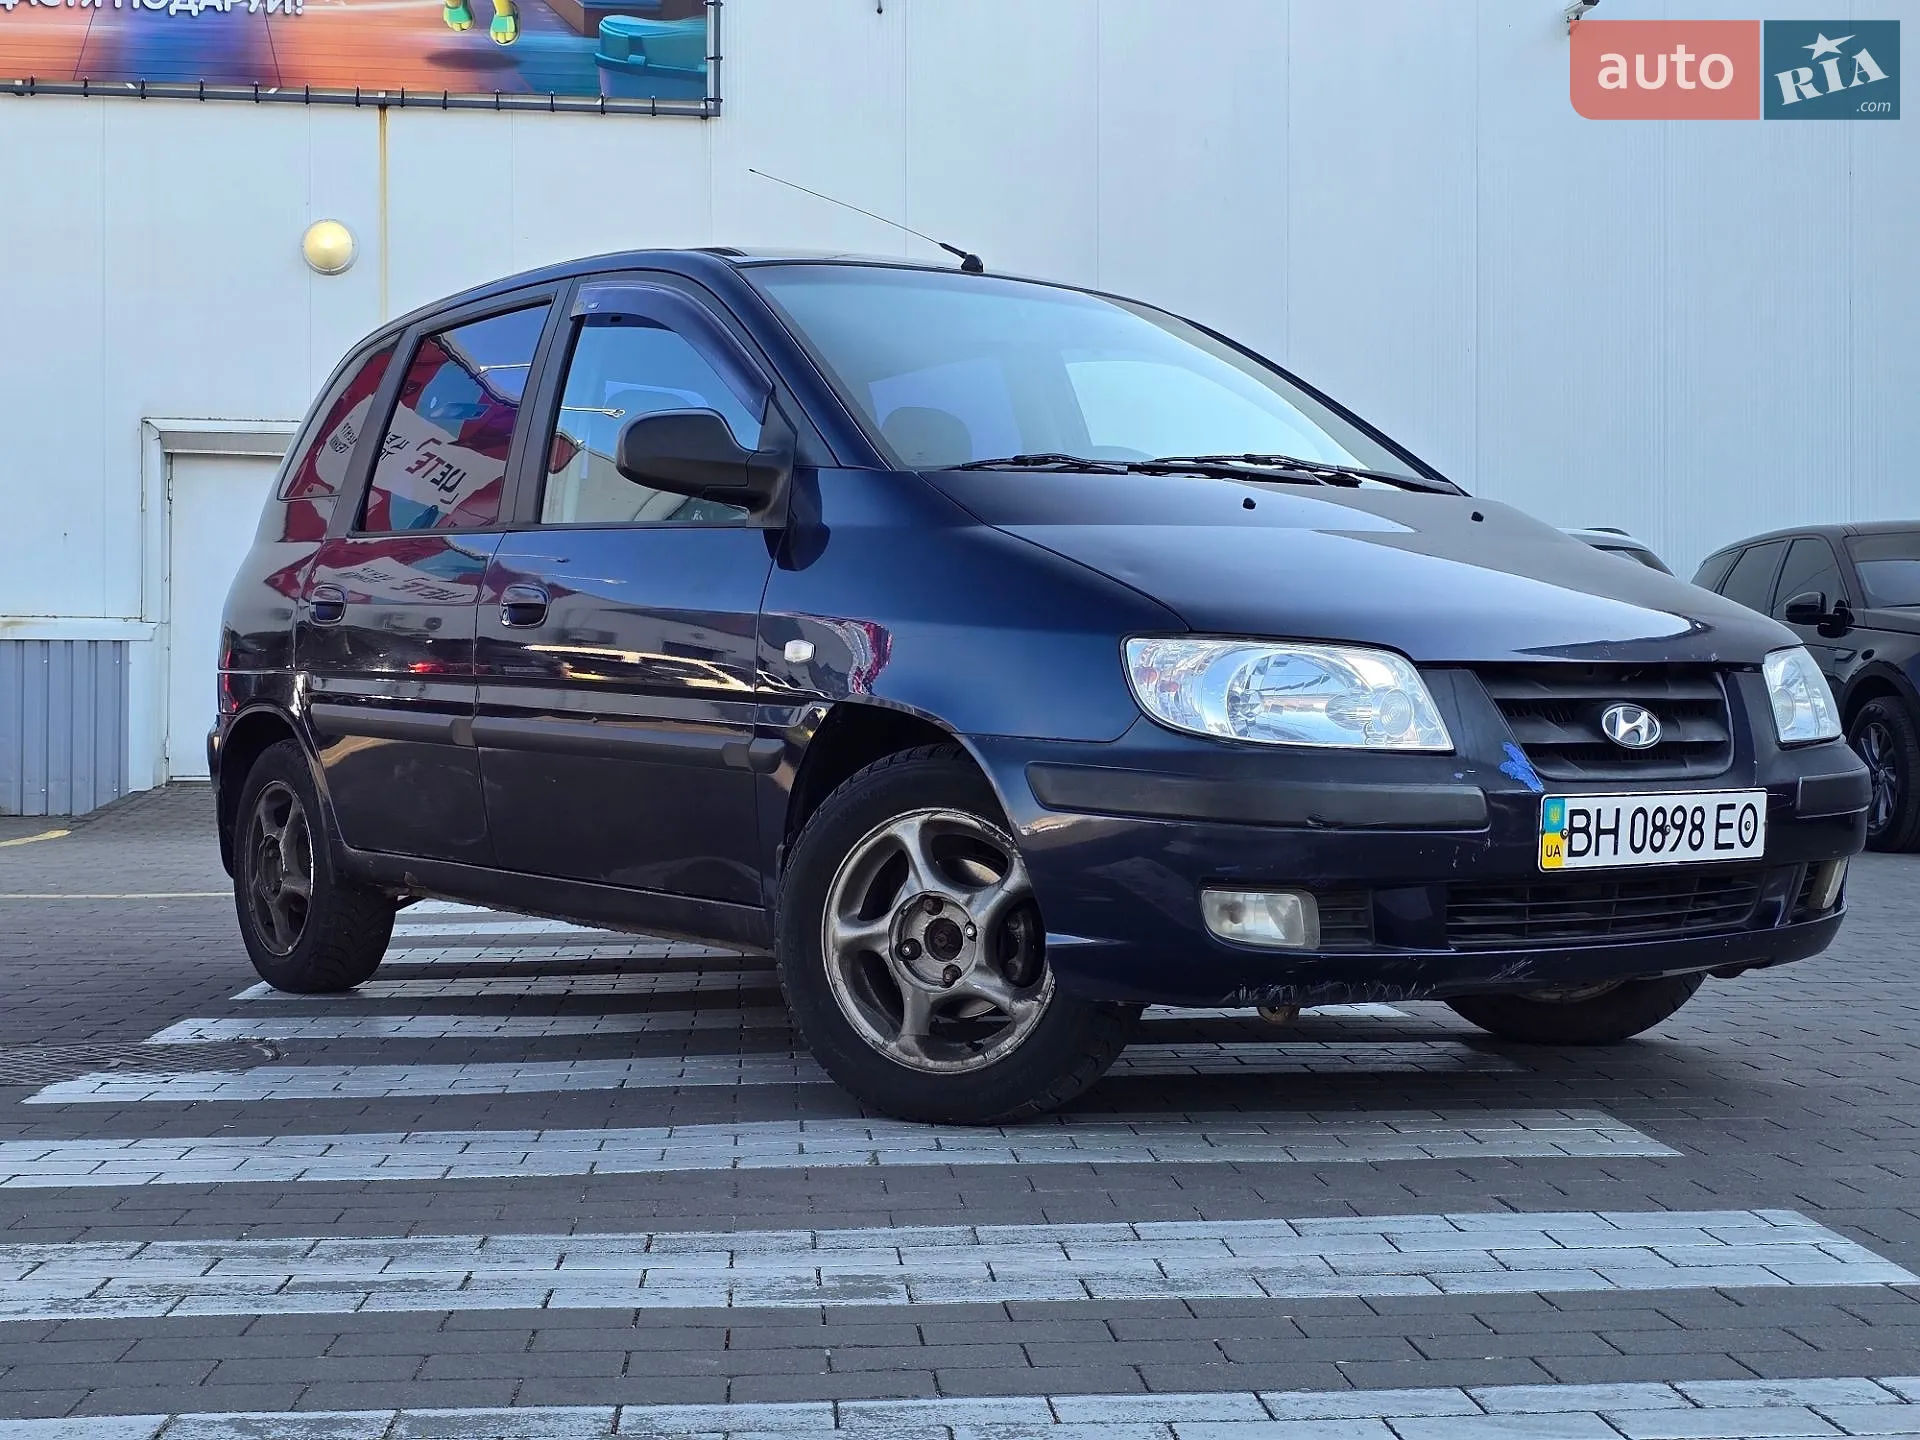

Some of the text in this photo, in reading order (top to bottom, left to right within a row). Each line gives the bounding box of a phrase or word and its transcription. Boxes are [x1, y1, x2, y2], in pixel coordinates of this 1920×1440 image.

[1568, 807, 1621, 858] BH
[1629, 804, 1706, 854] 0898
[1545, 844, 1561, 858] UA
